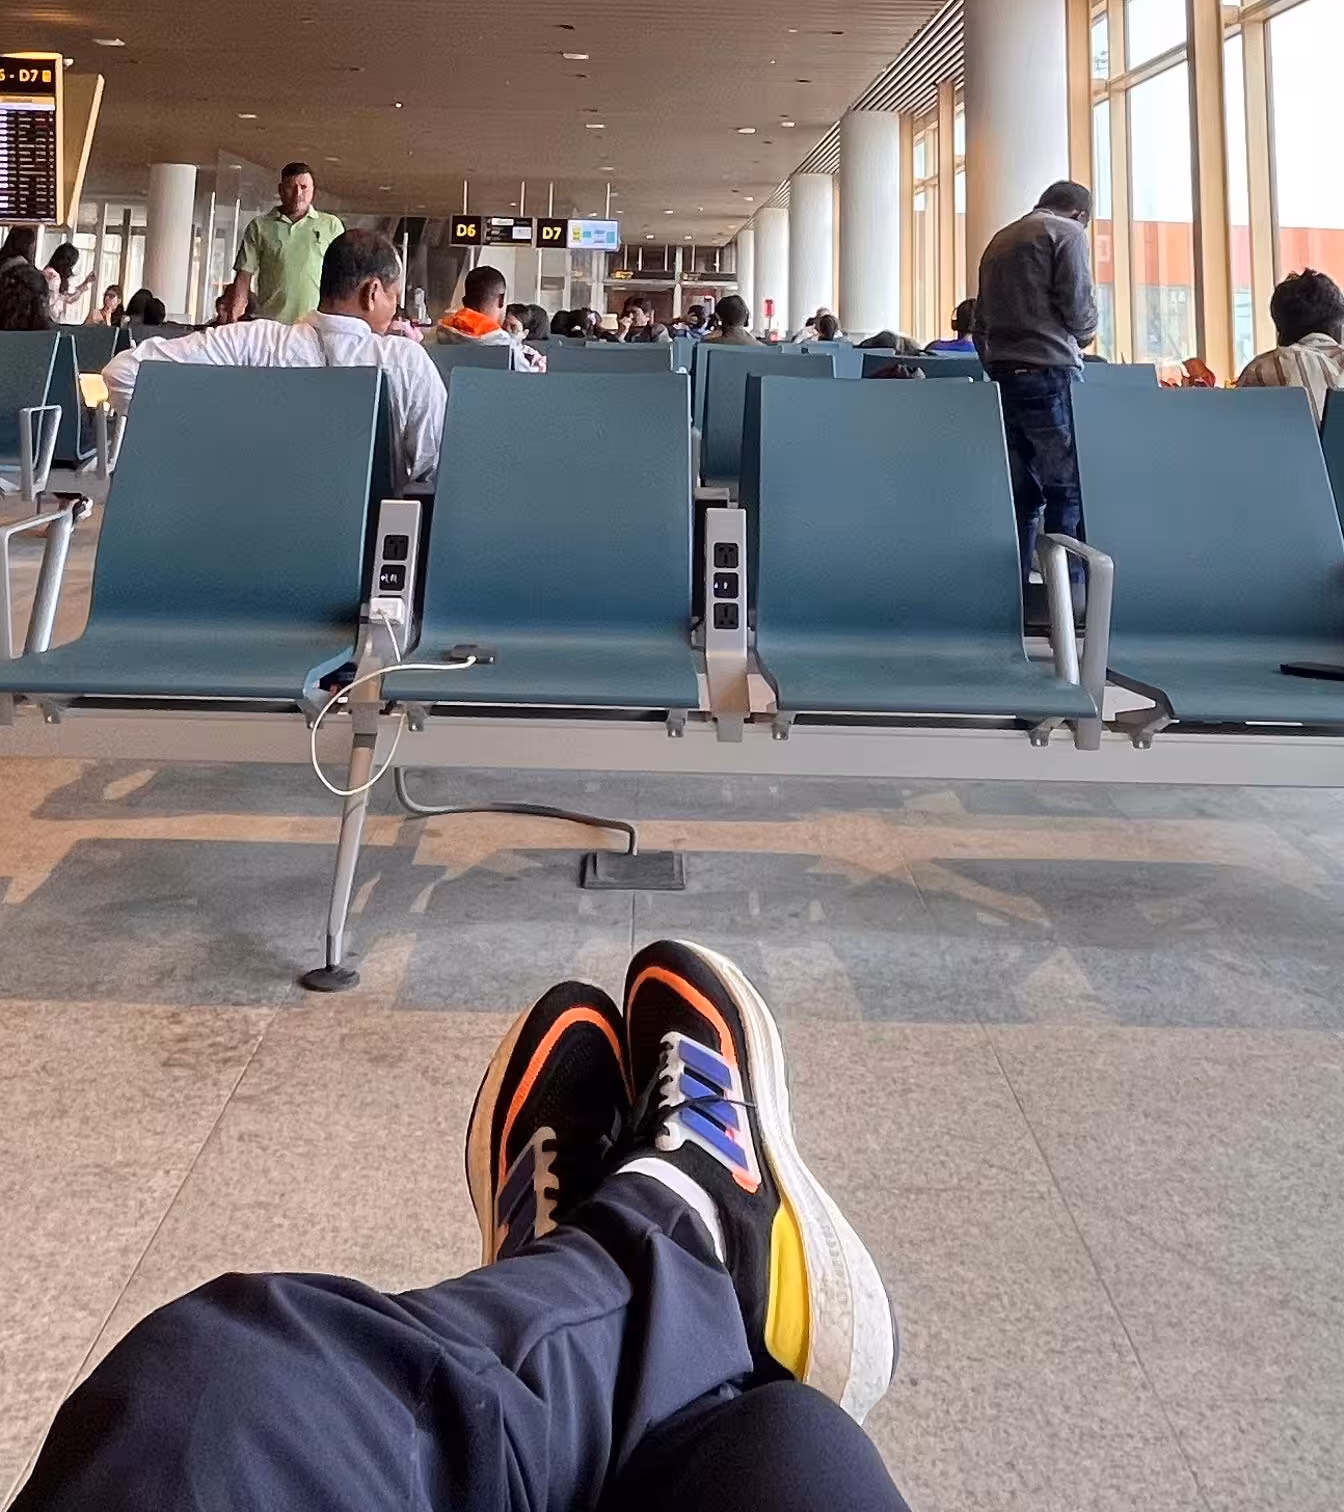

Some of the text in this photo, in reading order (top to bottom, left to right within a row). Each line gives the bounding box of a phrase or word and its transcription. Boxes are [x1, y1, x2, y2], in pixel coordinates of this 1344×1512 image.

[19, 69, 39, 82] D7
[456, 224, 476, 237] D6
[542, 226, 562, 240] D7
